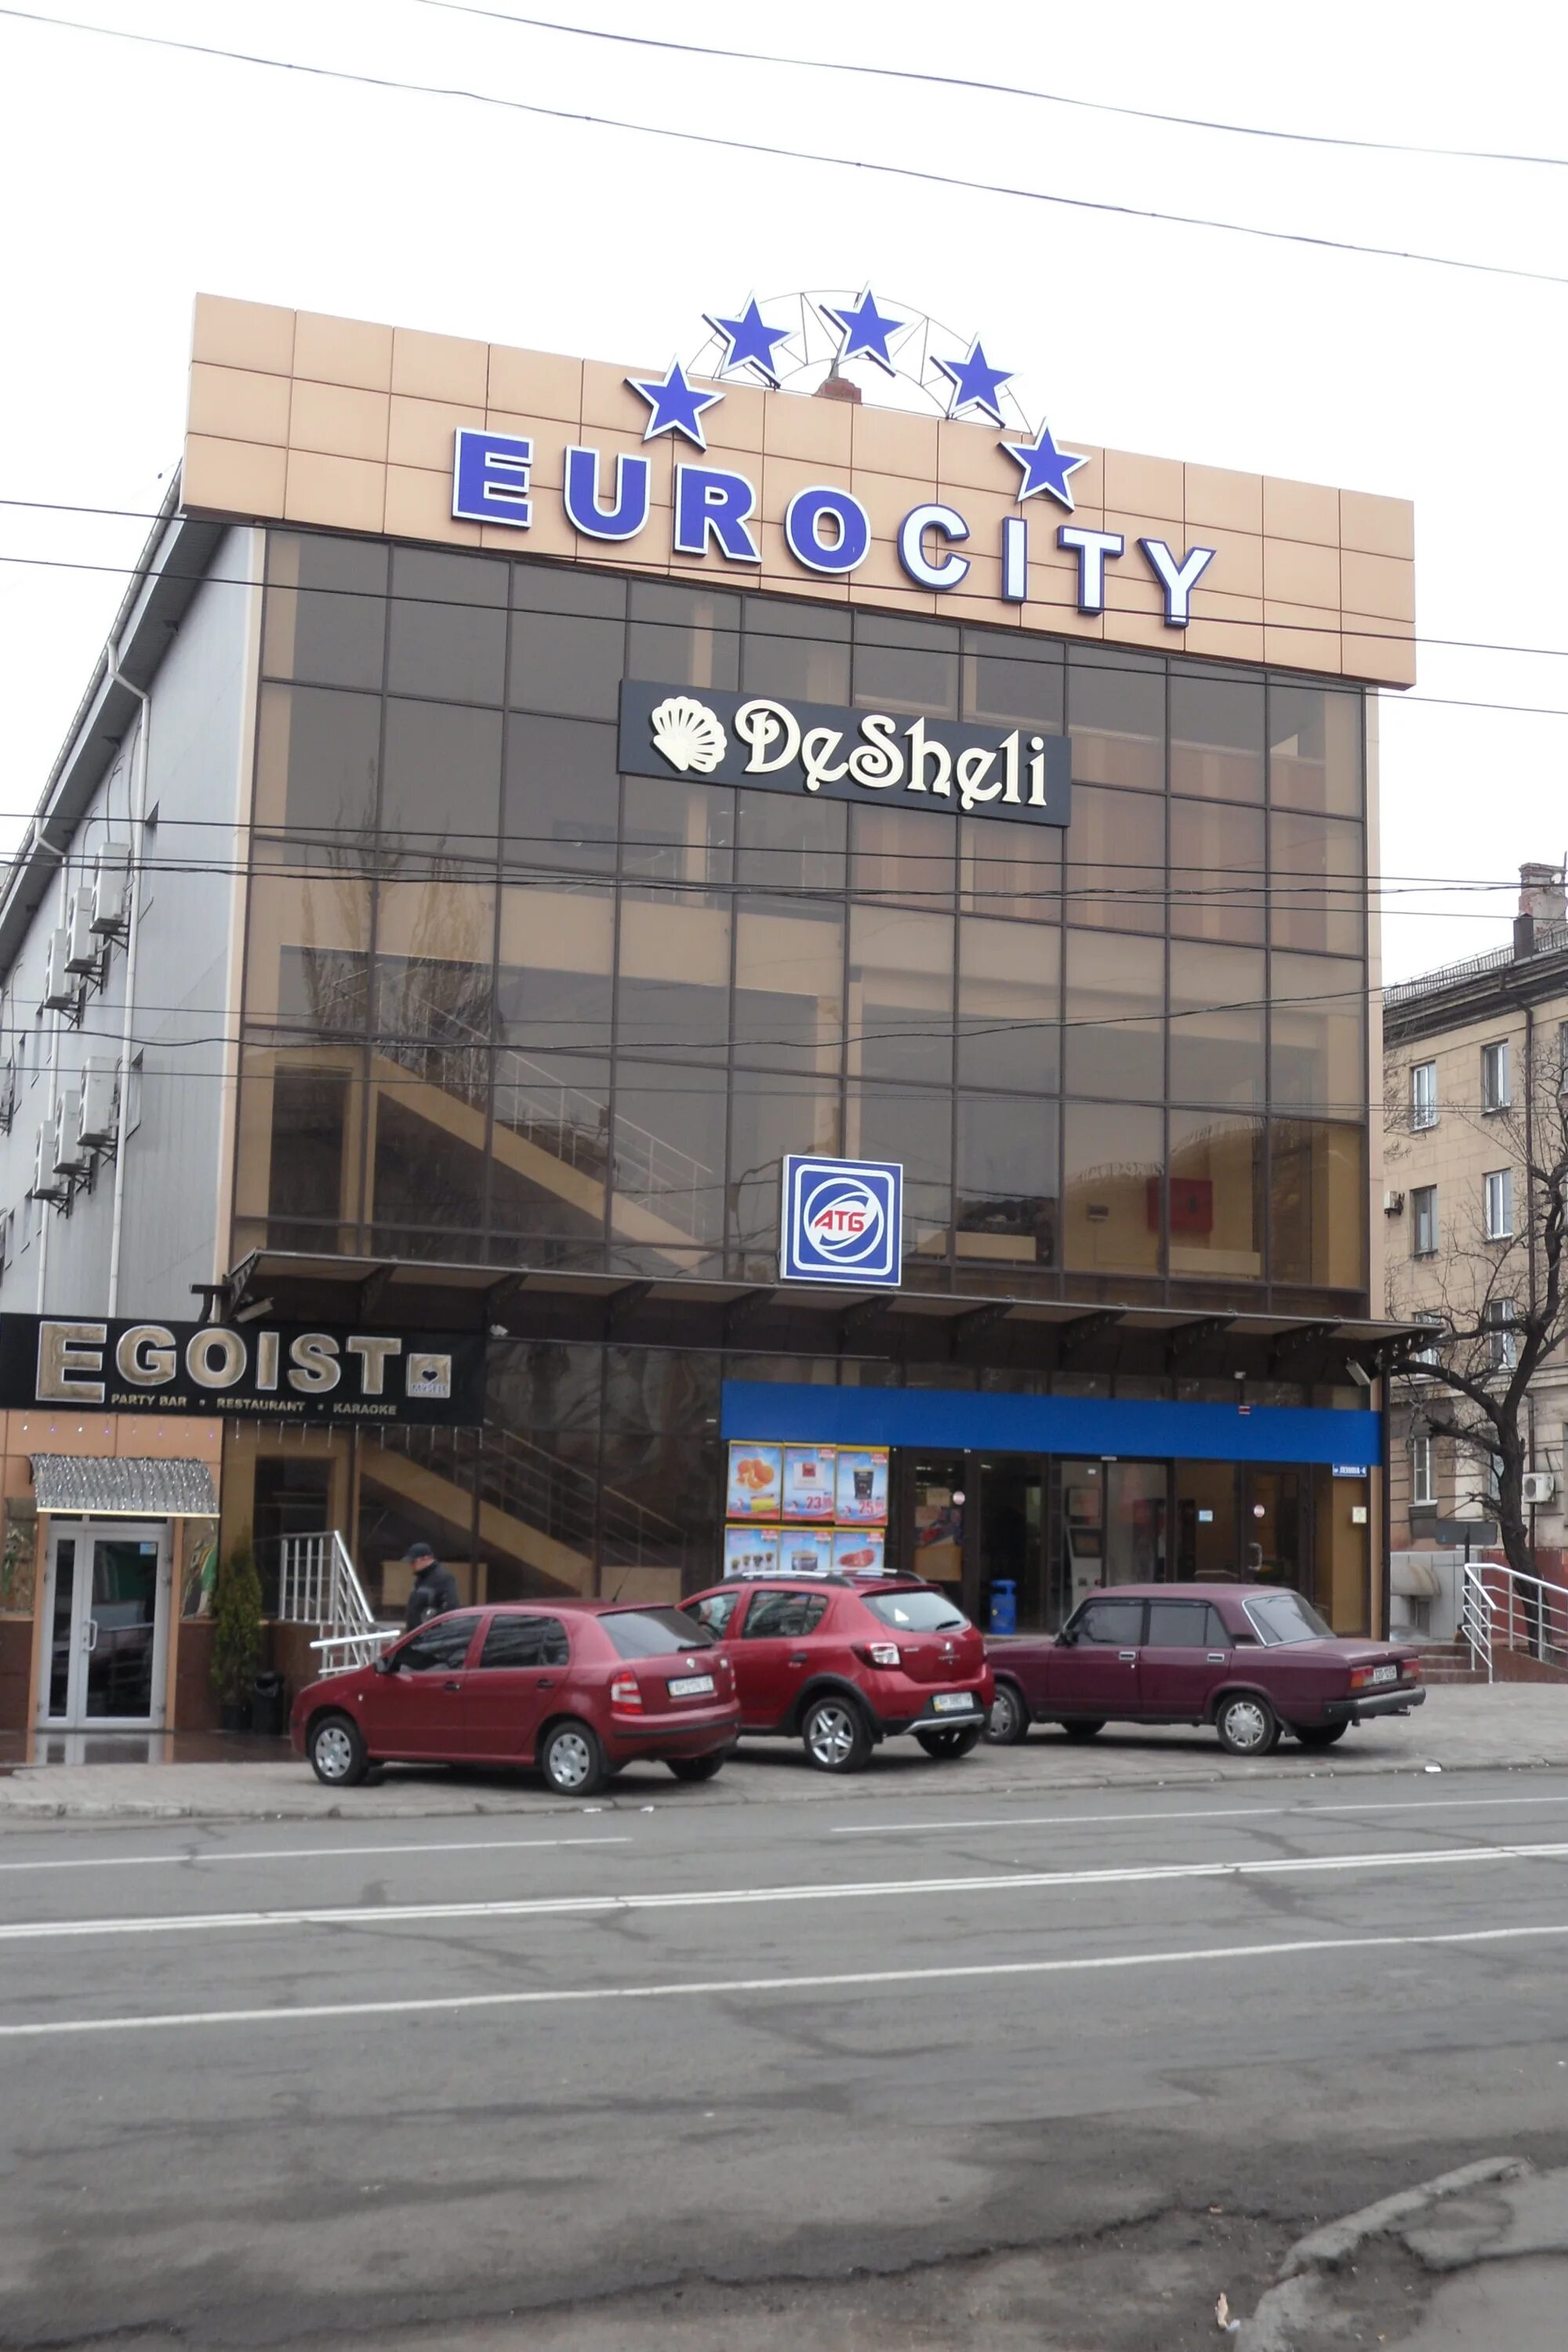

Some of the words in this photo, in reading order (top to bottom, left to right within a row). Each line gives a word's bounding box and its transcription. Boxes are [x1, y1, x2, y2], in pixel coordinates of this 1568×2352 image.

[735, 698, 1047, 810] DeSheli
[815, 1210, 866, 1232] АТБ
[35, 1320, 402, 1403] EGOIST
[111, 1393, 155, 1406] PARTY
[159, 1396, 187, 1408] BAR
[216, 1398, 306, 1412] RESTAURANT
[333, 1403, 397, 1415] KARAOKE
